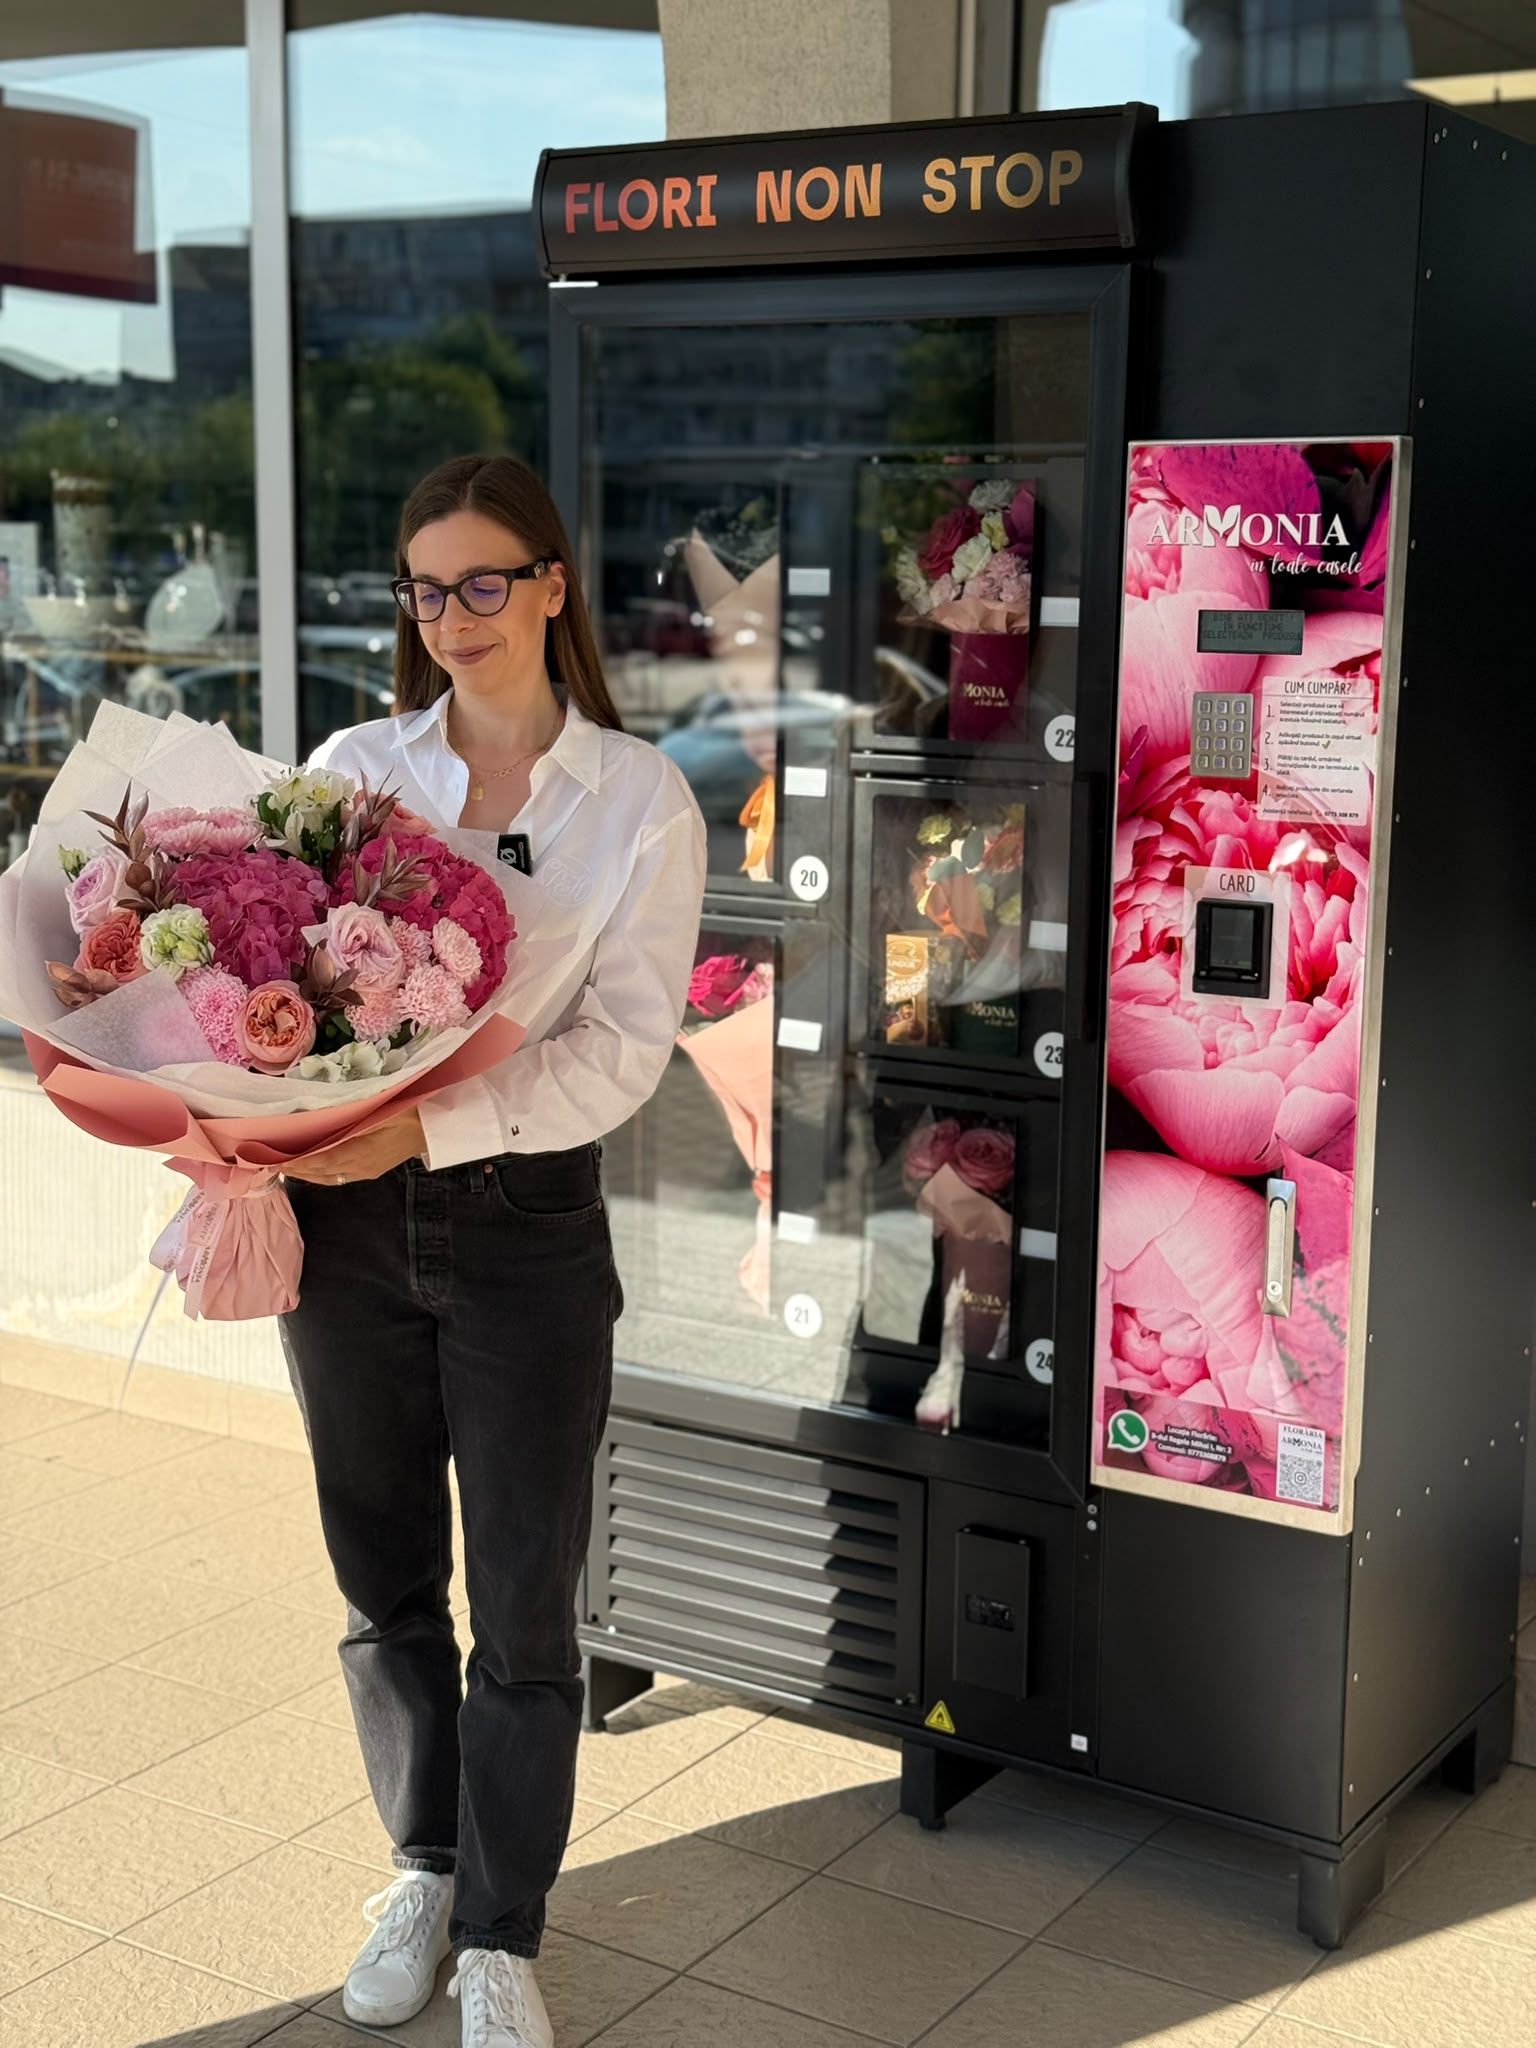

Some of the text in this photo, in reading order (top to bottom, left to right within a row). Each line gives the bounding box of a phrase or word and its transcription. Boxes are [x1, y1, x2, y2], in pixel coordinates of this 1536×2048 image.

[565, 150, 1083, 233] FLORI NON STOP
[1146, 504, 1350, 547] ARMONIA
[1271, 553, 1310, 575] toate
[1317, 551, 1364, 576] casele
[1285, 680, 1352, 695] CUM CUMPĂR?
[1266, 704, 1275, 718] 1.
[1055, 728, 1075, 748] 22
[1264, 731, 1273, 745] 2.
[1263, 758, 1273, 771] 3.
[1262, 784, 1271, 797] 4.
[800, 869, 818, 887] 20
[1219, 873, 1255, 893] CARD
[794, 1306, 809, 1324] 21
[1036, 1351, 1054, 1370] 24
